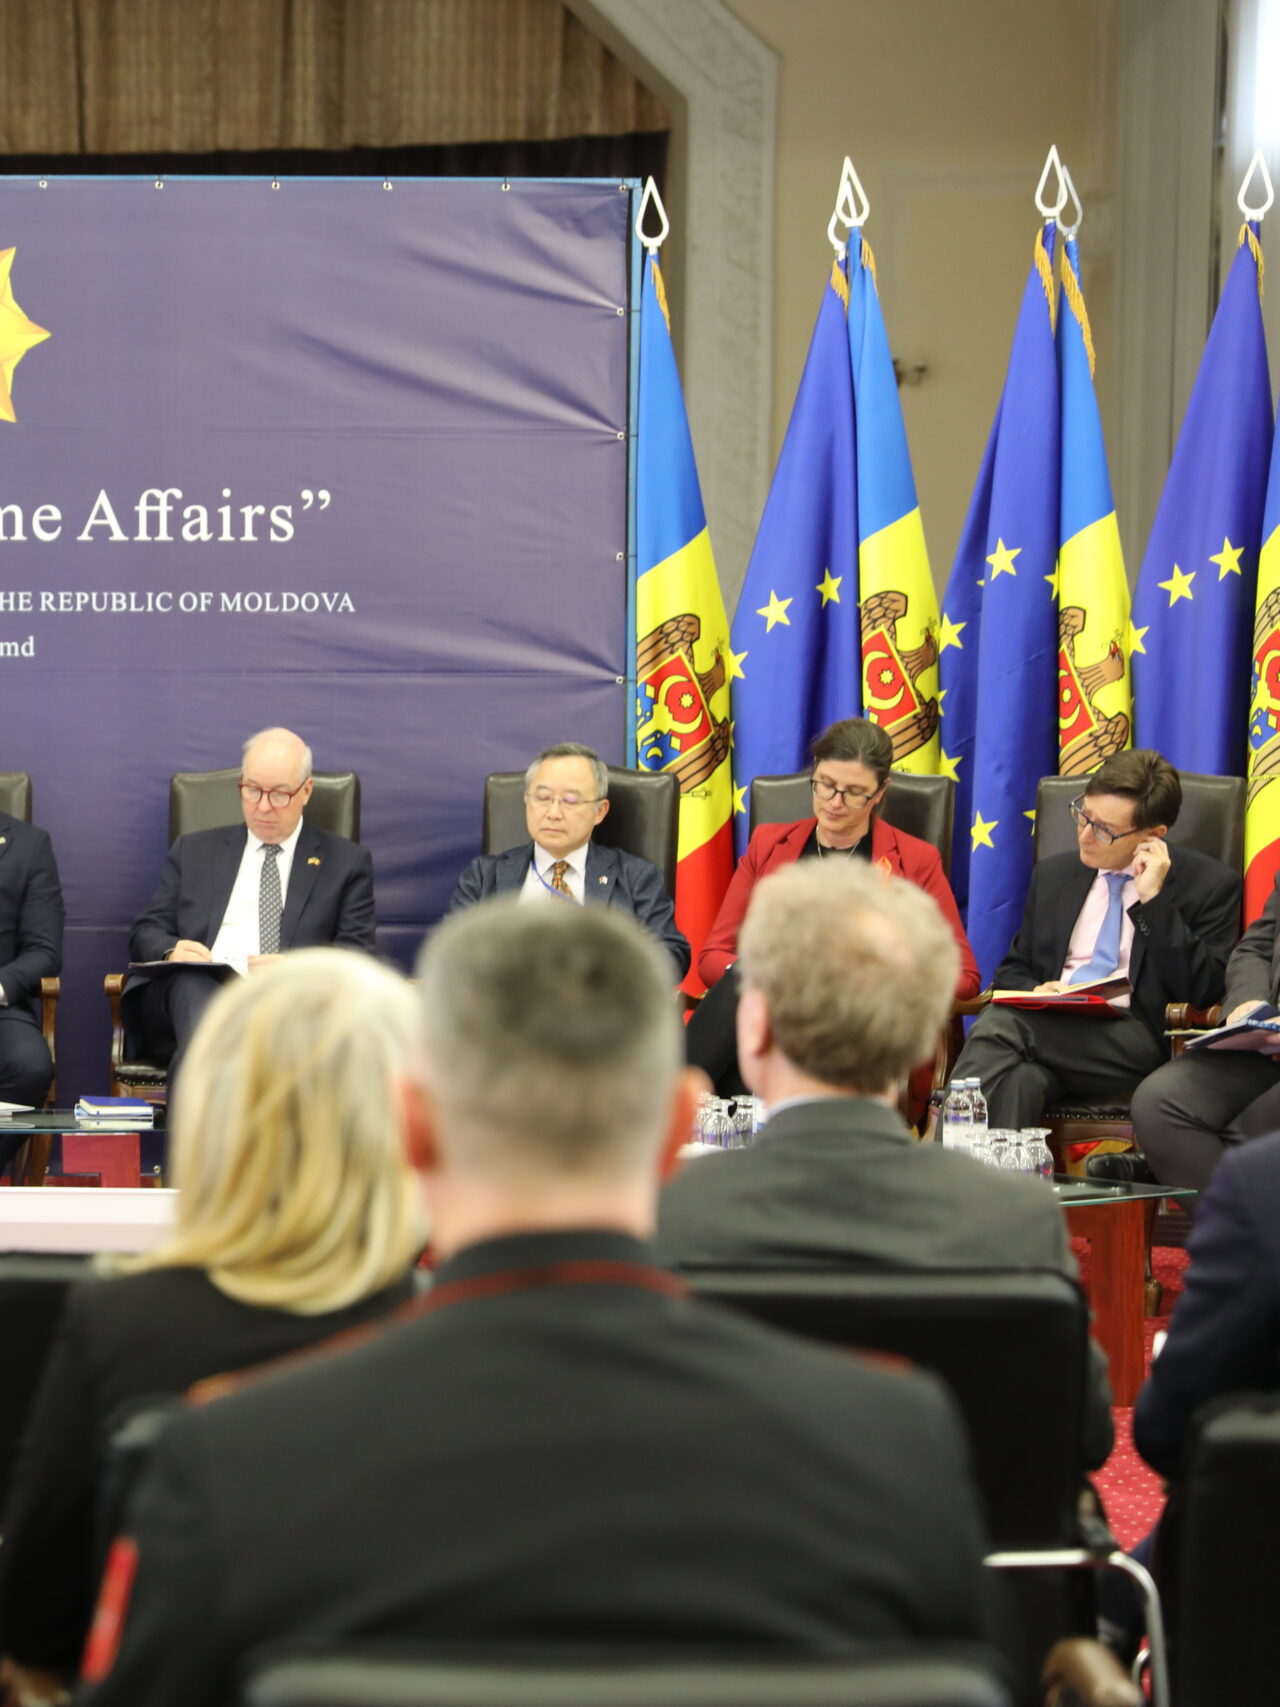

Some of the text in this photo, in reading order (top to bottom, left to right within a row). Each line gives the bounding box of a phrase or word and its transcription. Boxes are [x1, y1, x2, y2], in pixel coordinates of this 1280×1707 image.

[75, 487, 332, 543] Affairs”
[39, 591, 173, 613] REPUBLIC
[178, 591, 214, 613] OF
[219, 591, 356, 614] MOLDOVA
